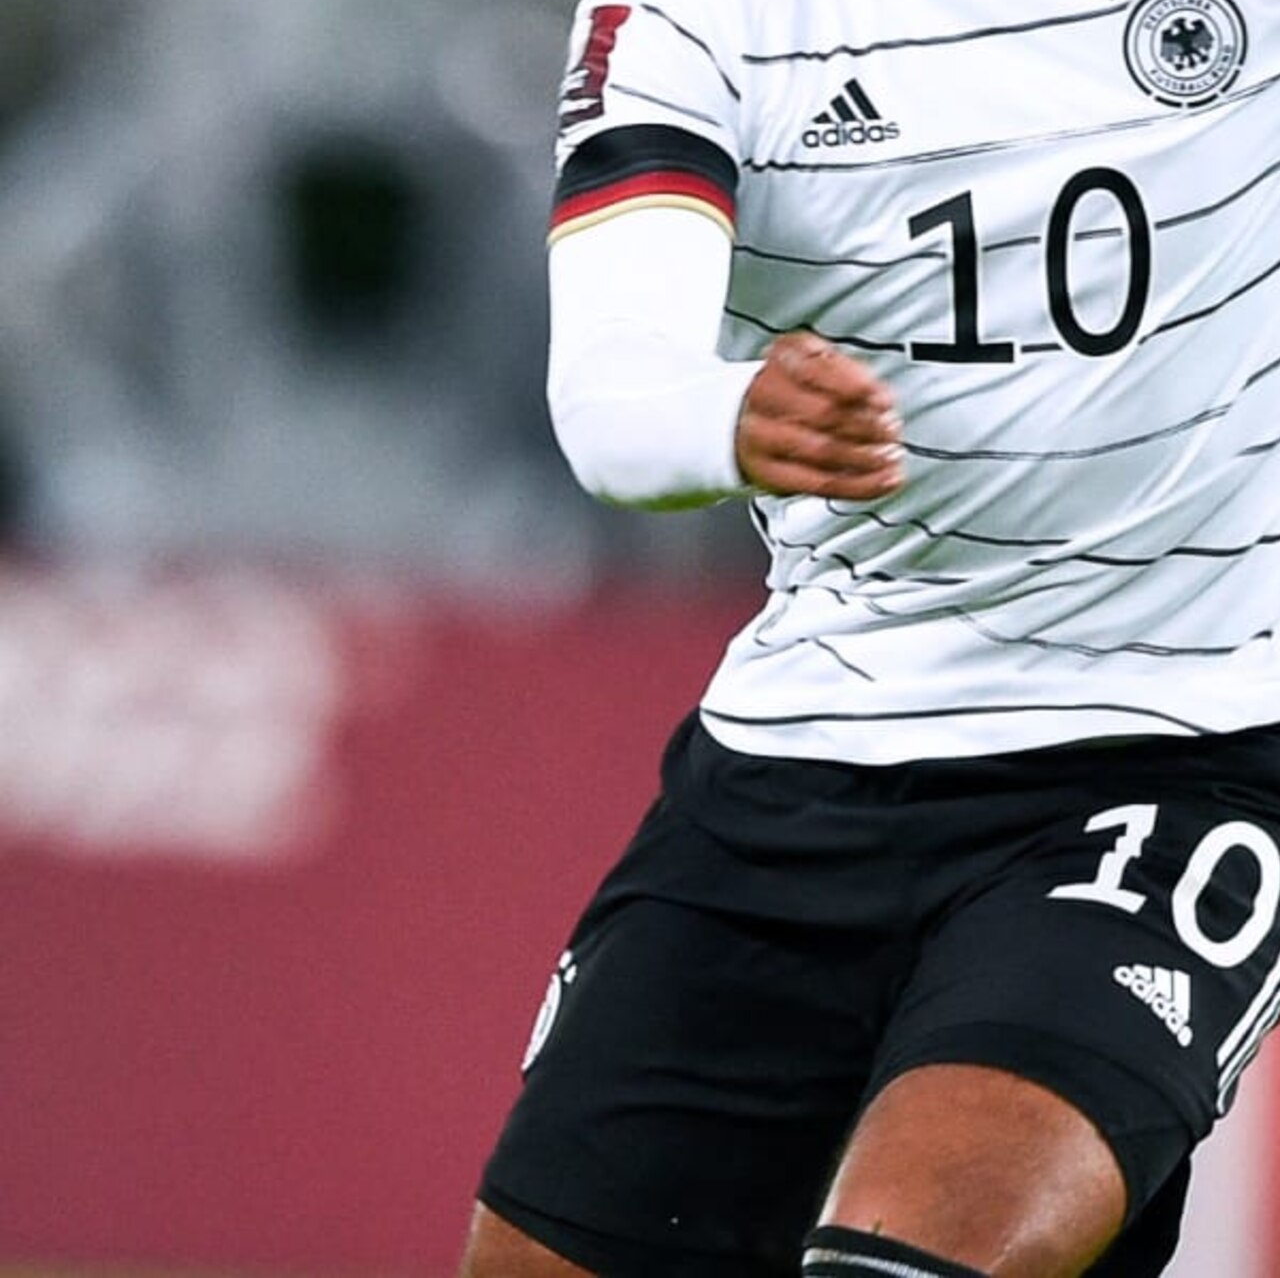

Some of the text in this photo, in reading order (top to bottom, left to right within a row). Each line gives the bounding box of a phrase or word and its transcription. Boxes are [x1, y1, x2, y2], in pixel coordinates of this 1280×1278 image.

[801, 121, 900, 149] adidas
[908, 166, 1151, 364] 10
[1113, 965, 1193, 1047] adidas
